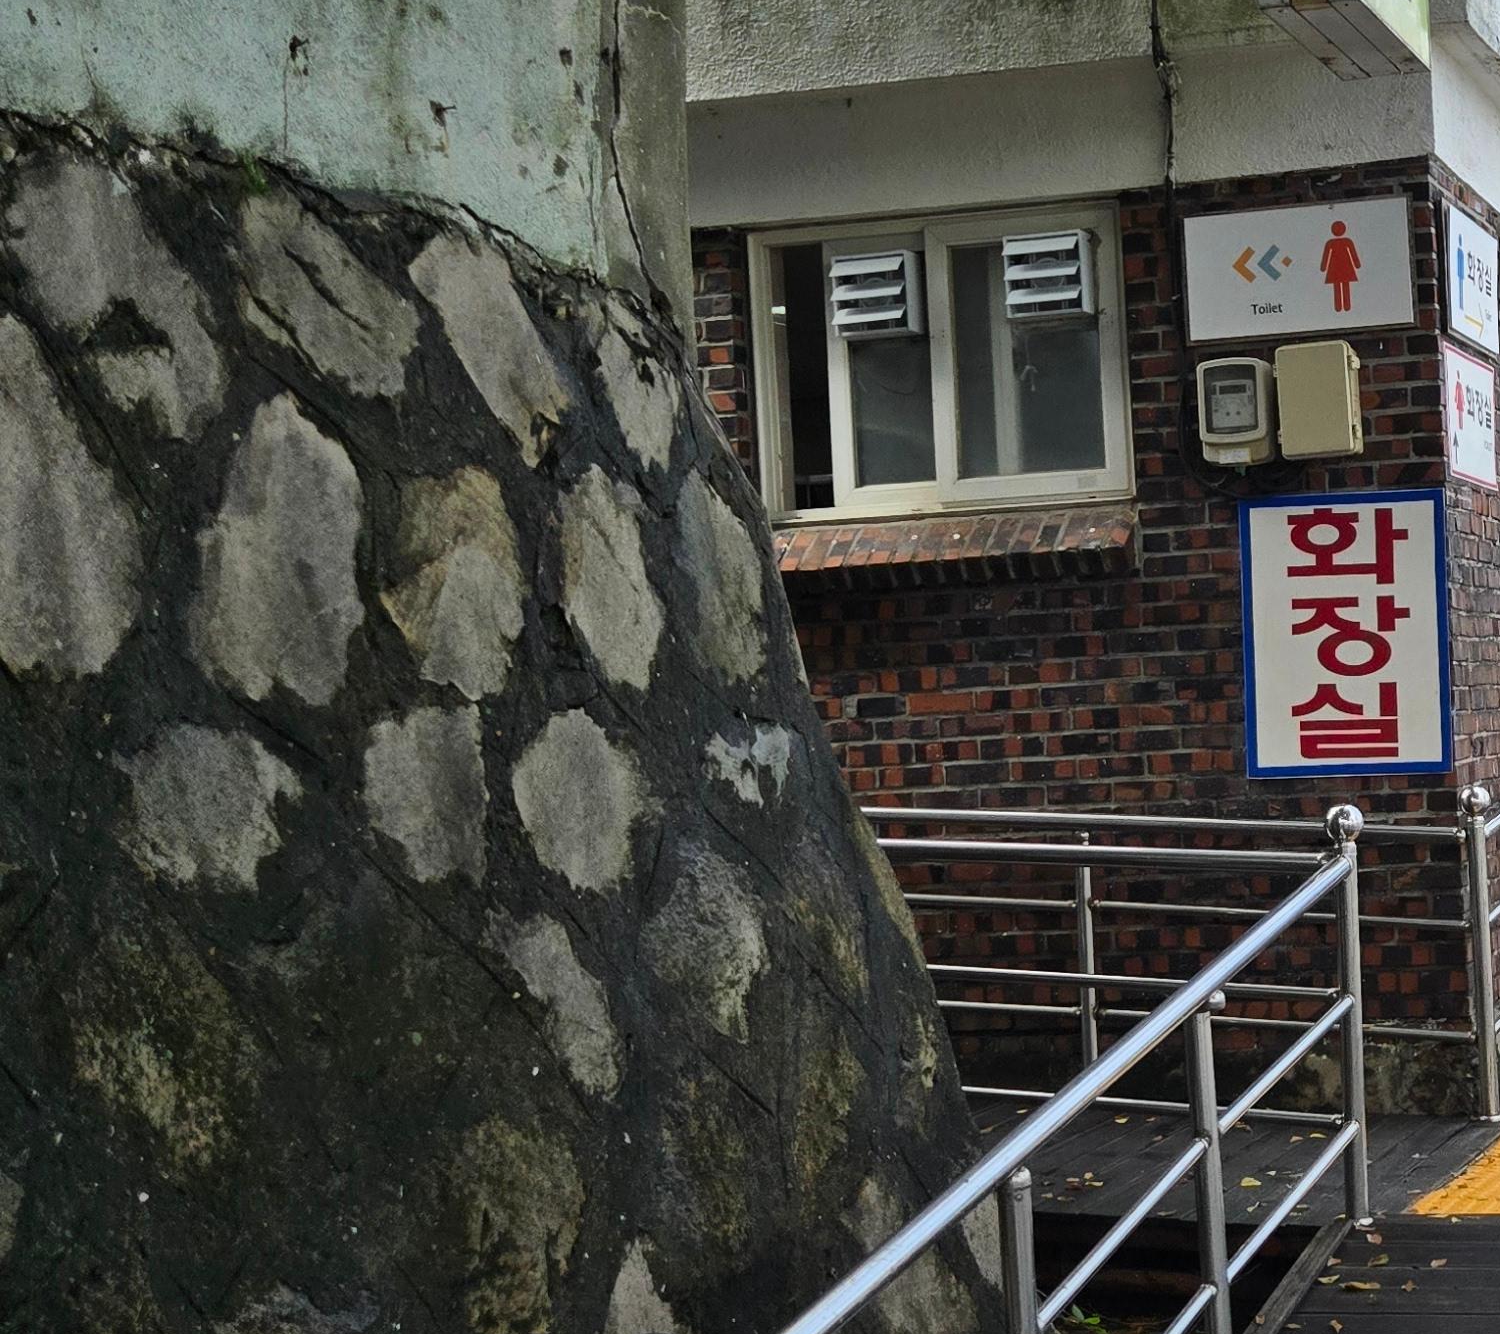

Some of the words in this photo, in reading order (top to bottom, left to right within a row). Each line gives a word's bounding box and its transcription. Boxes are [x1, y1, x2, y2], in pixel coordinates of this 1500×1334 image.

[1467, 250, 1493, 298] 화장실
[1251, 303, 1283, 316] Toilet
[1466, 380, 1492, 430] 화장실
[1287, 507, 1411, 759] 화장실
